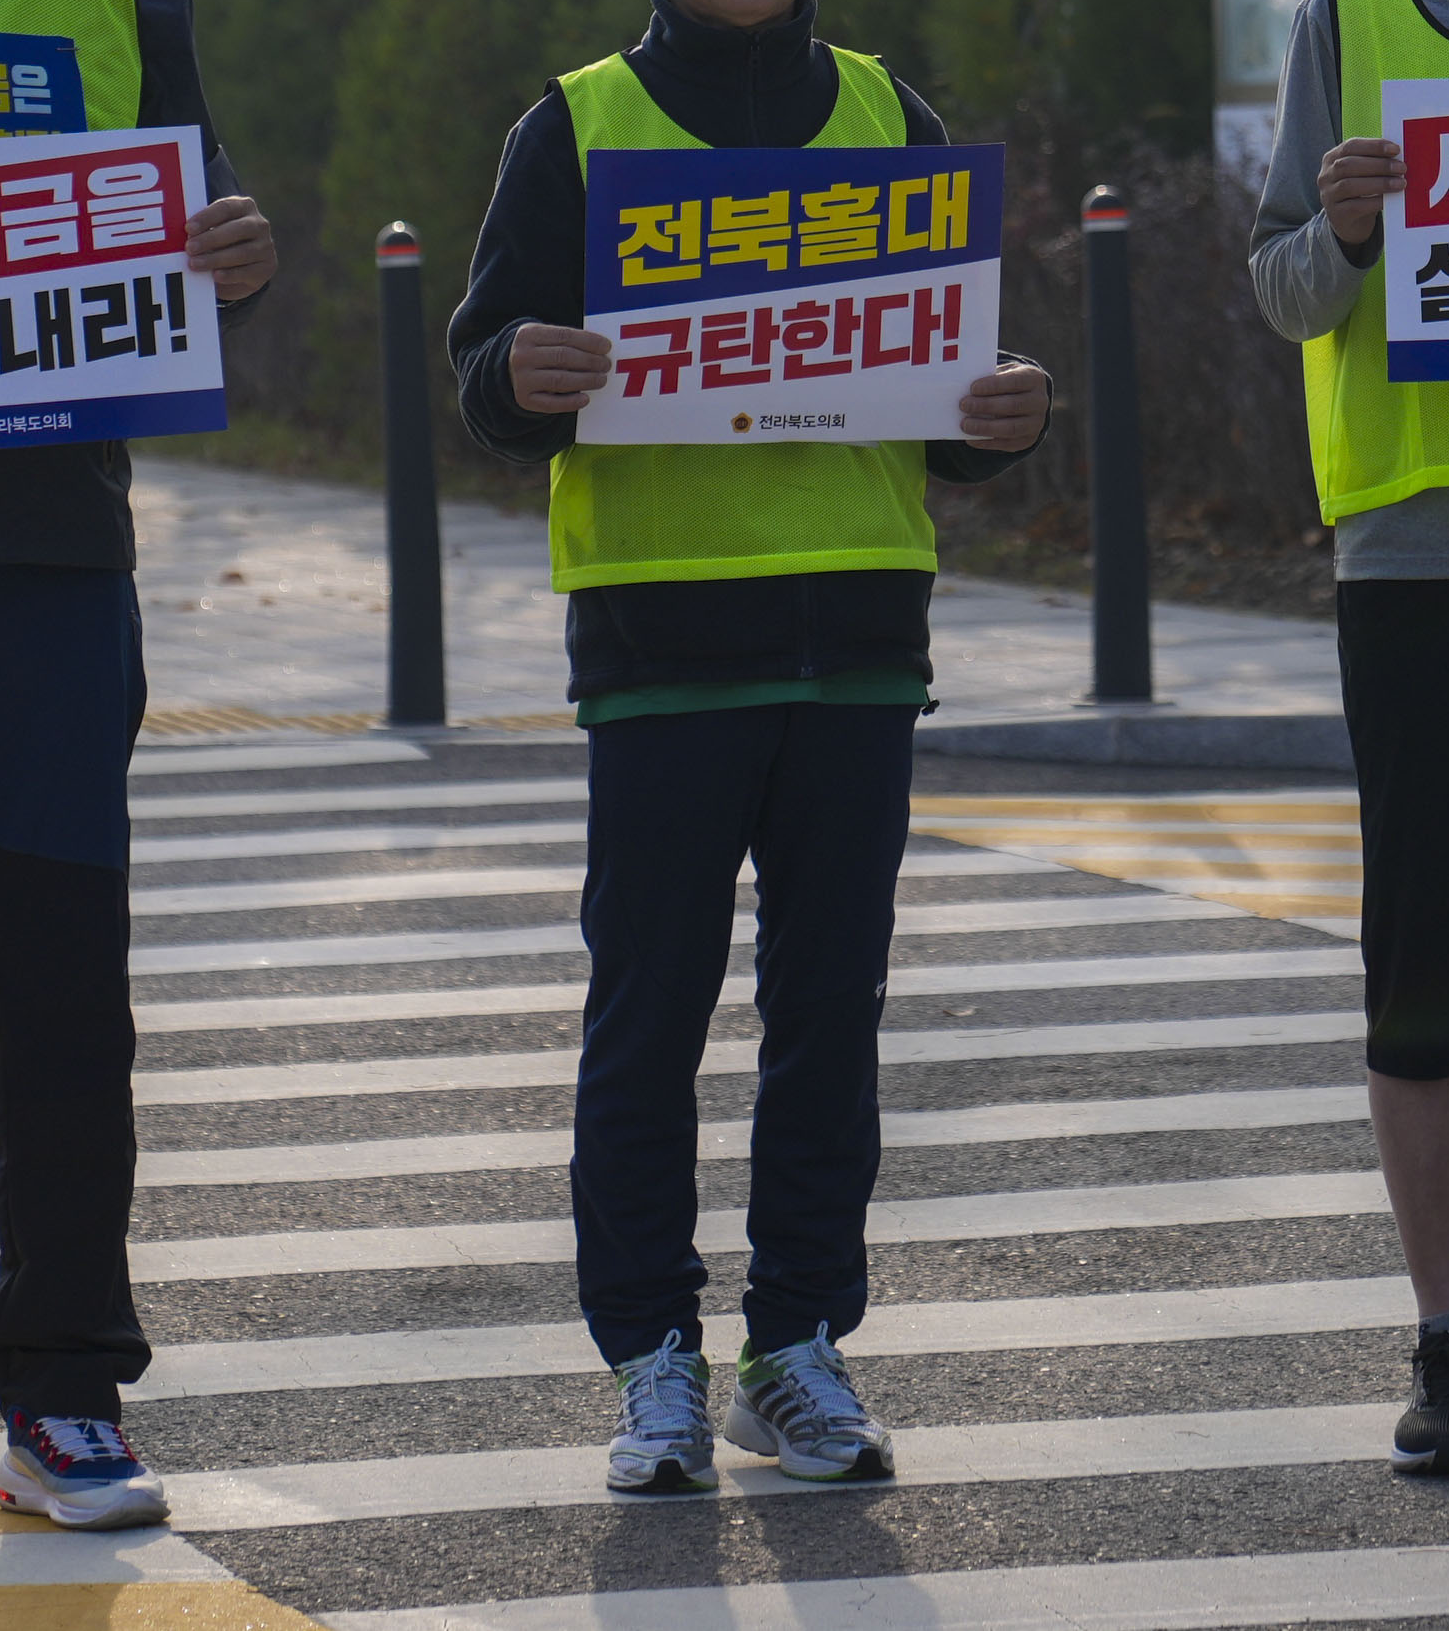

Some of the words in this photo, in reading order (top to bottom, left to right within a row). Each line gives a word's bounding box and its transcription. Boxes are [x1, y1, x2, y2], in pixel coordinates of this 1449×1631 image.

[617, 170, 970, 287] 전북홀대
[615, 284, 962, 398] 규탄한다!
[758, 413, 846, 430] 전라북도의회
